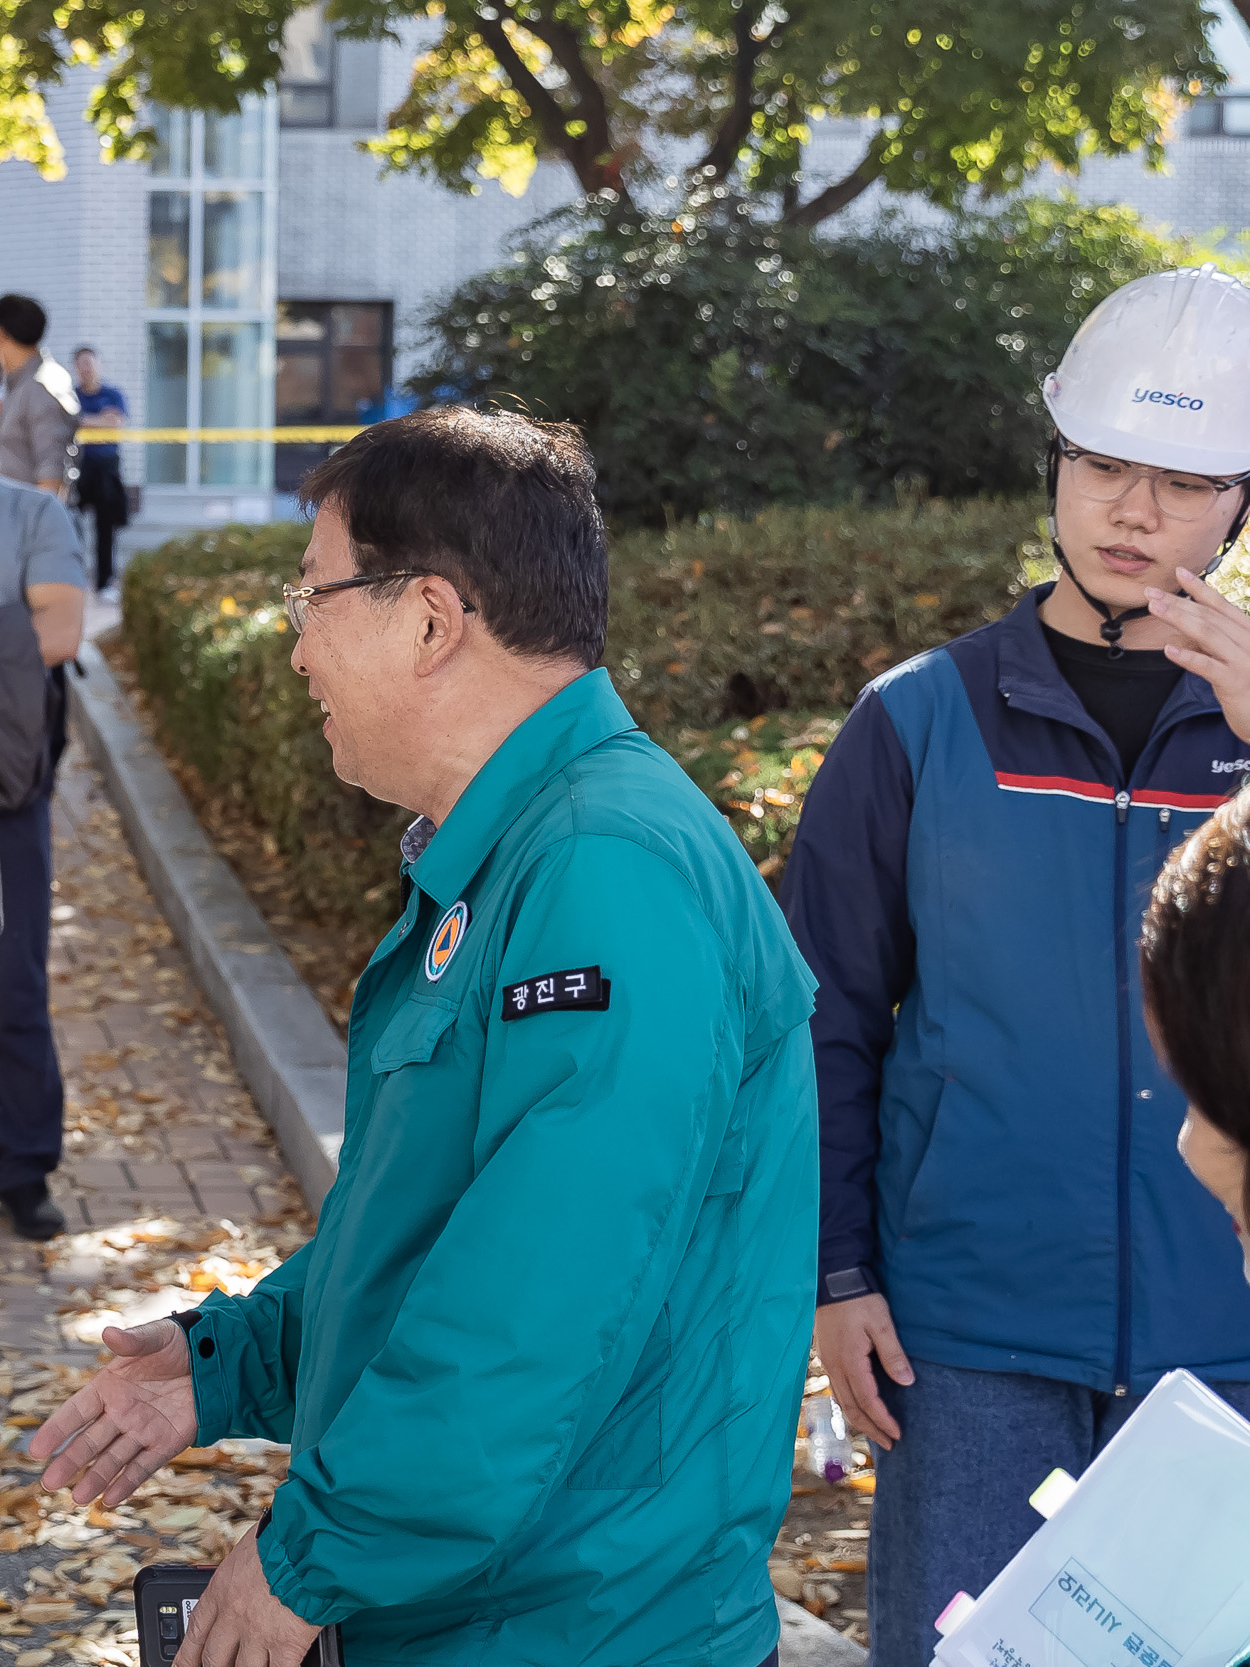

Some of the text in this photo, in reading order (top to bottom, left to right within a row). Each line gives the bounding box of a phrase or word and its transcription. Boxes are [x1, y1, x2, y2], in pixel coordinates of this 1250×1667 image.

[1131, 388, 1204, 411] yesco
[512, 973, 587, 1010] 광진구
[1058, 1571, 1122, 1633] 시나리오
